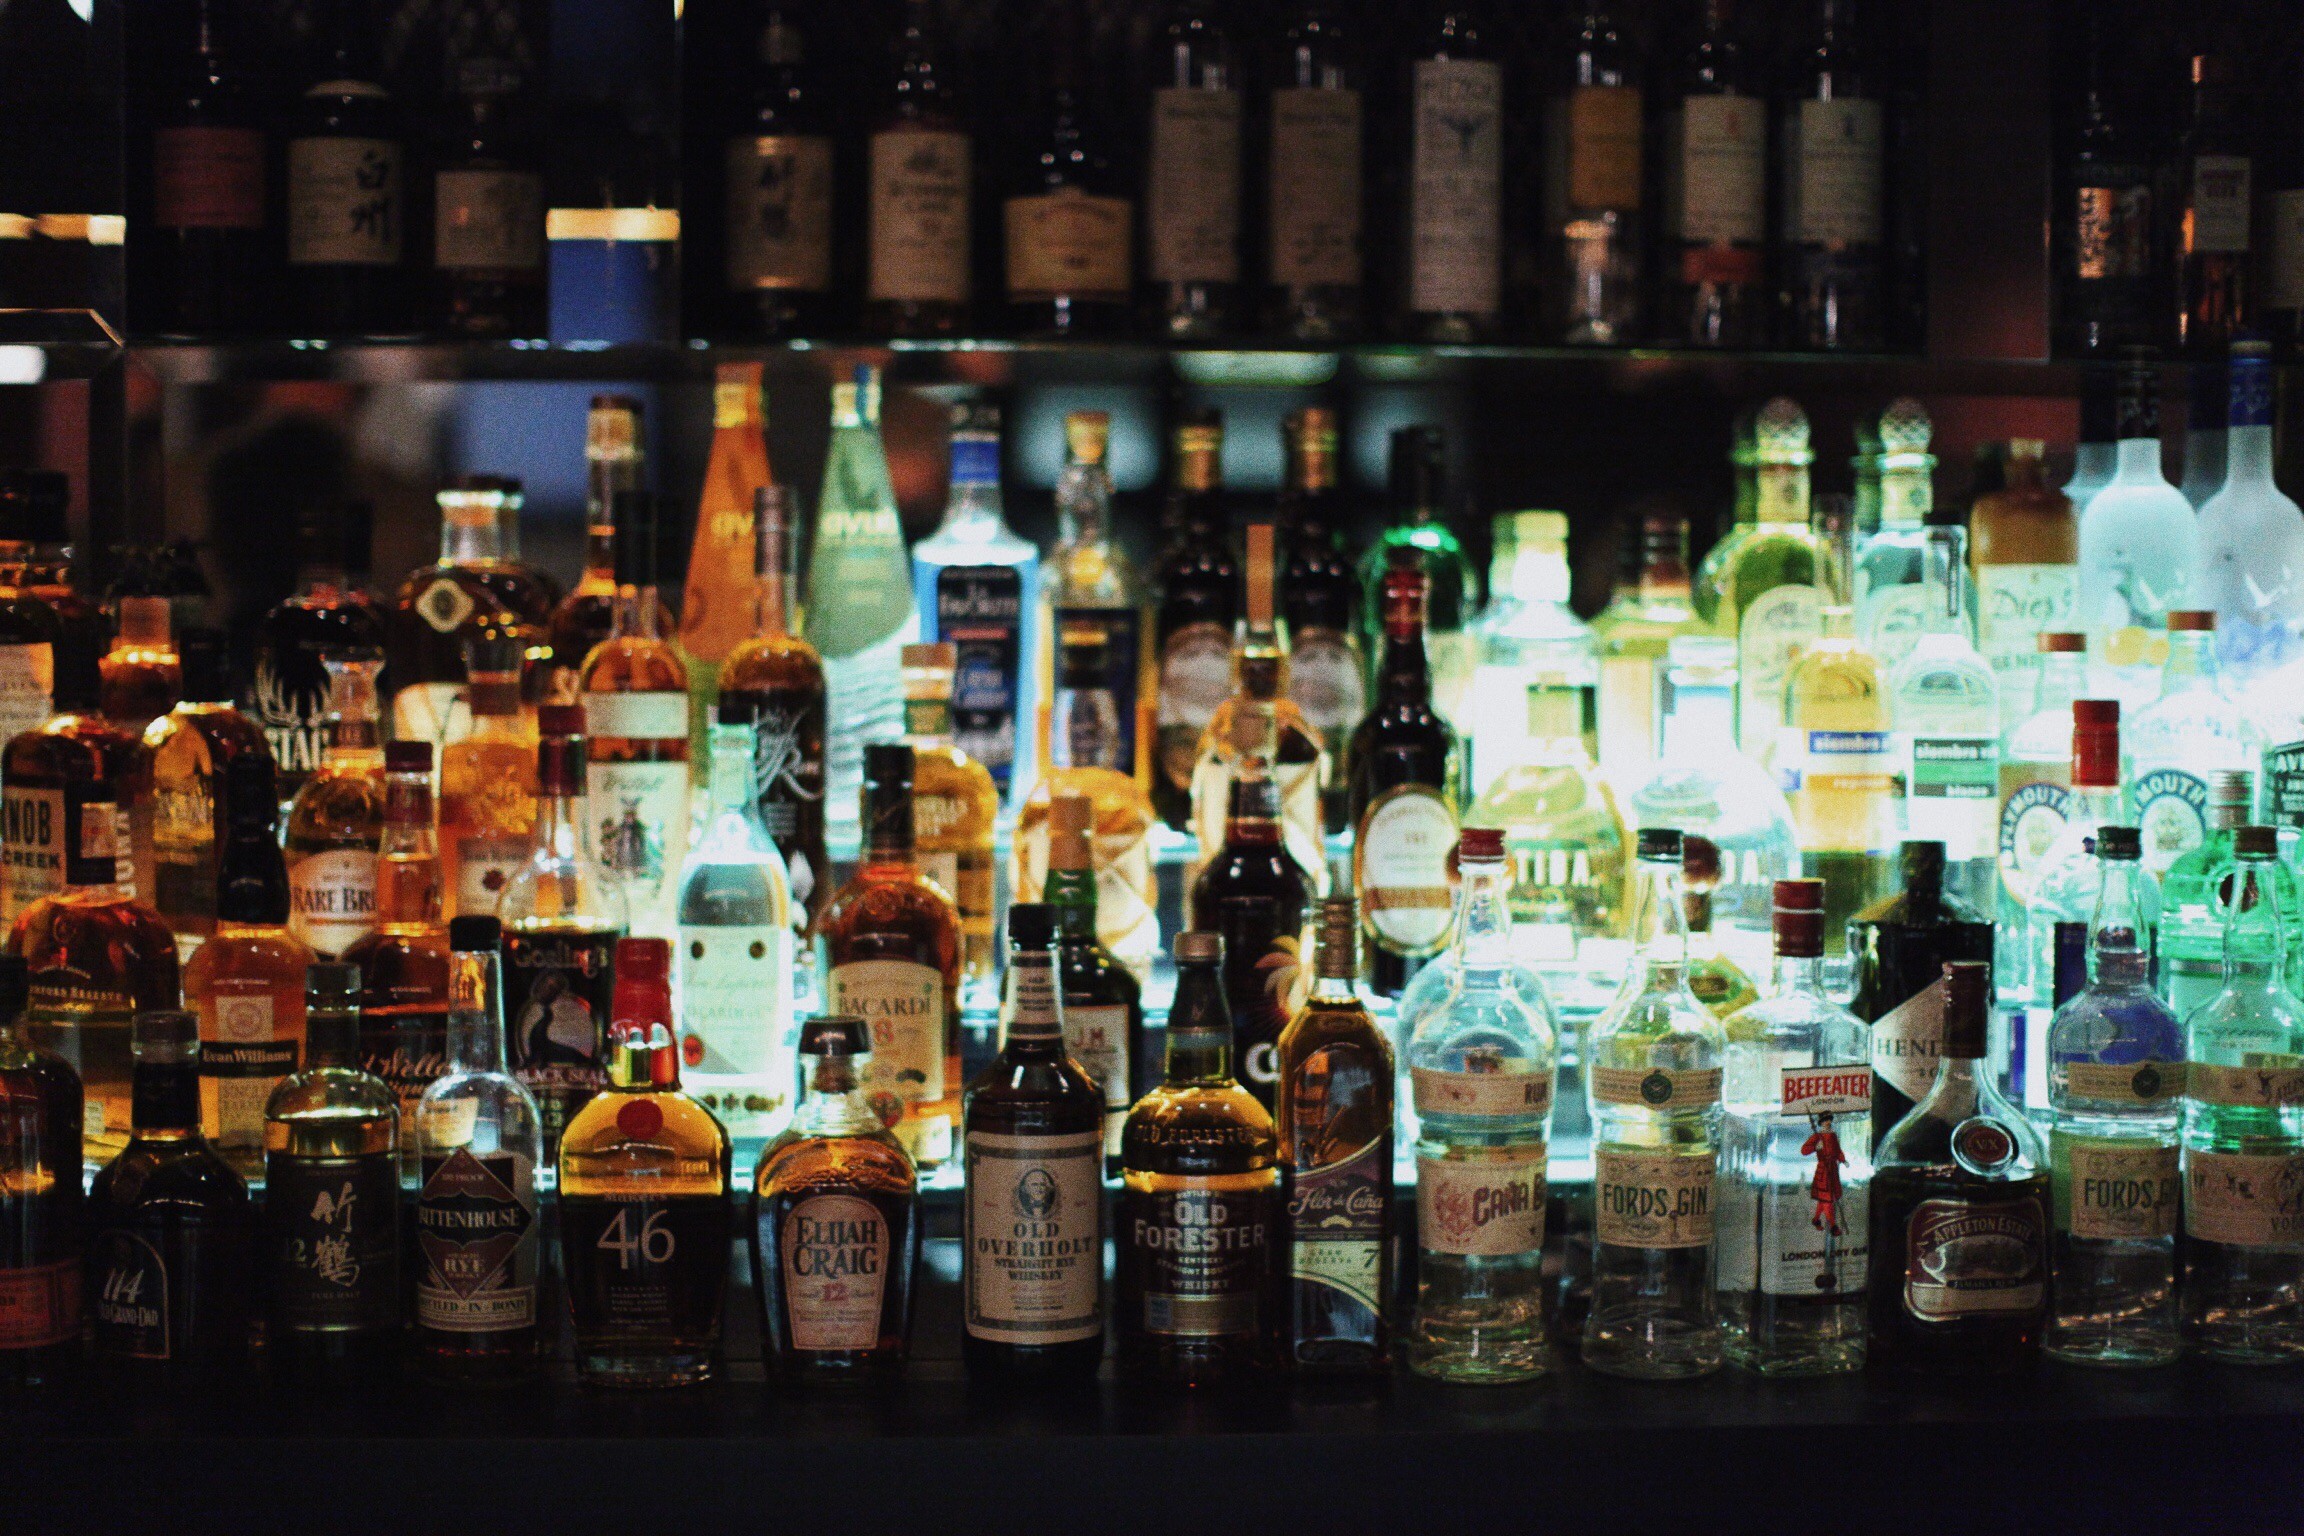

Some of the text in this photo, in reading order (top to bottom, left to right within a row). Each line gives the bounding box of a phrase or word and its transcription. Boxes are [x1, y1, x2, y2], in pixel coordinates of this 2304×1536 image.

[1917, 743, 1978, 759] siembra
[3, 799, 51, 845] NOB
[202, 1047, 292, 1064] Evan Williams
[1784, 1074, 1870, 1104] BEEFEATER
[1603, 1184, 1707, 1217] FORDS GIN
[2084, 1178, 2153, 1209] FORDS
[418, 1206, 520, 1228] RITTENHOUSE
[1173, 1200, 1228, 1226] OLD
[597, 1207, 677, 1270] 46
[796, 1217, 877, 1248] ELIJAH
[1014, 1222, 1060, 1239] OLD
[1134, 1218, 1266, 1253] FORESTER
[1933, 1216, 2033, 1244] APPLETON ESTATE
[977, 1236, 1093, 1257] OVERHOLT
[1363, 1248, 1380, 1268] 7
[1782, 1251, 1826, 1262] LONDON
[444, 1258, 486, 1273] RYE
[793, 1244, 878, 1279] CRAIG
[102, 1266, 144, 1305] 114
[822, 1282, 849, 1302] 12
